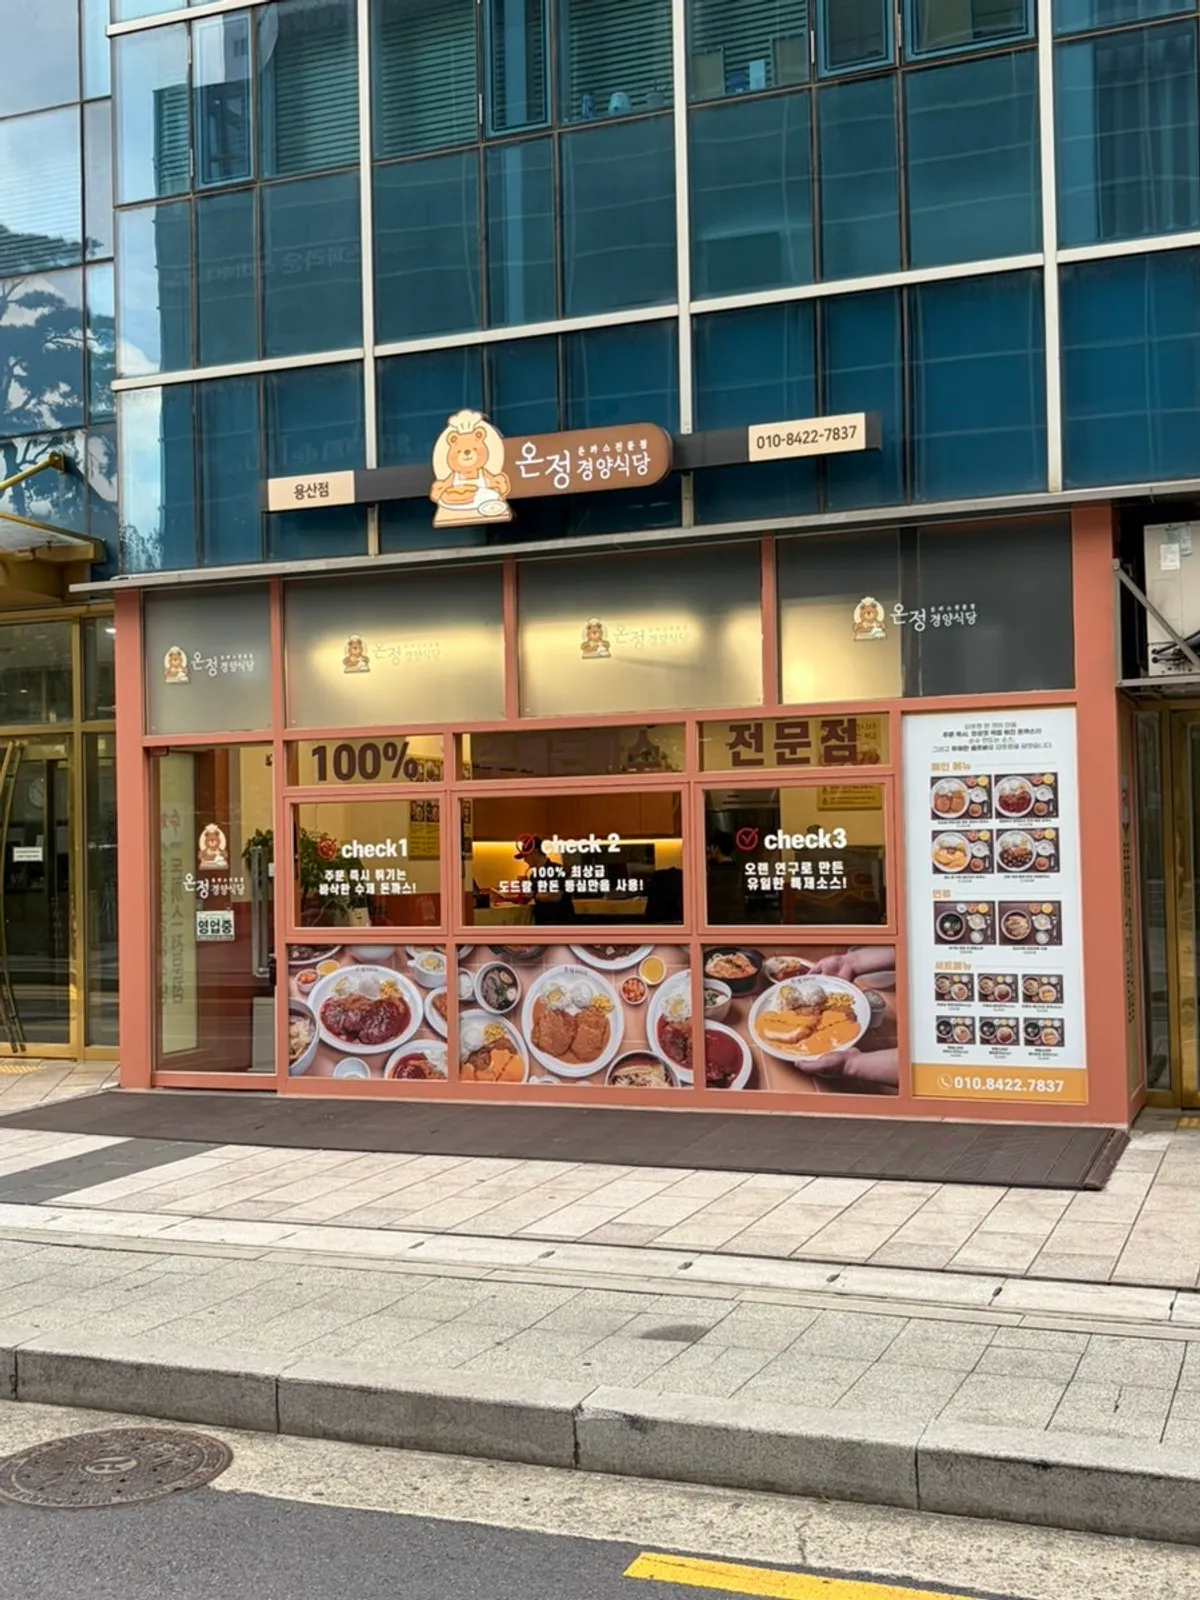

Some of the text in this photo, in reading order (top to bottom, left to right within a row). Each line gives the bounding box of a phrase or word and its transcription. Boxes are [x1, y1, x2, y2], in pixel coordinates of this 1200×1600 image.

[757, 425, 857, 449] 010-8422-7837
[514, 441, 651, 489] 온정 경양식당
[293, 481, 329, 500] 용산점
[889, 603, 977, 632] 온정 경양식당
[190, 651, 218, 677] 온정
[726, 718, 857, 767] 전문점
[312, 741, 419, 782] 100%
[541, 833, 621, 855] check 2
[324, 868, 407, 882] 주문 즉시 튀기는
[531, 865, 606, 878] 100% 최상급
[744, 860, 844, 876] 오랜 연구로 만든
[183, 873, 209, 899] 온정
[319, 881, 417, 896] 바삭한 수제 돈까스!
[499, 879, 644, 893] 도드람 한돈 등심만을 사용!
[747, 876, 847, 891] 유일한 특제소스!
[198, 919, 232, 934] 영업중
[954, 1076, 1064, 1093] 010.8422.7837
